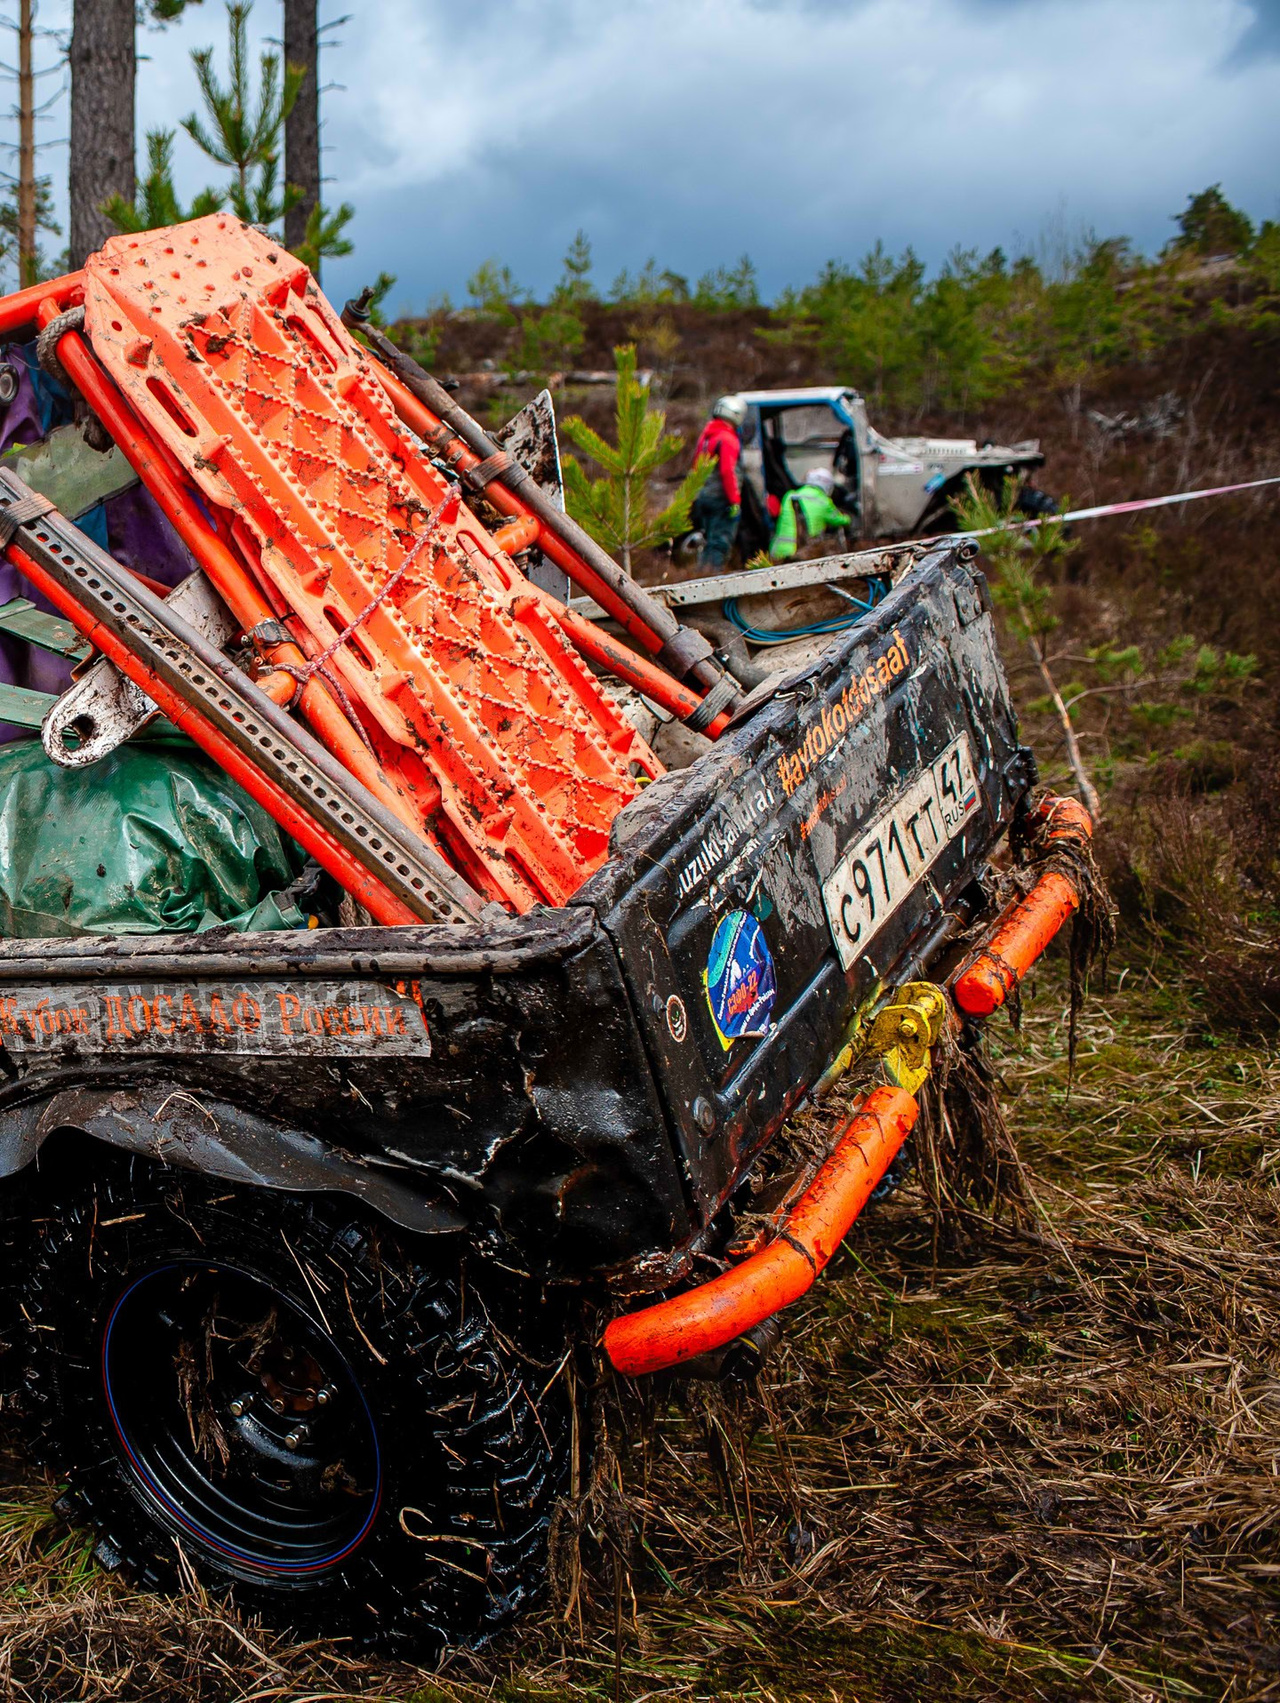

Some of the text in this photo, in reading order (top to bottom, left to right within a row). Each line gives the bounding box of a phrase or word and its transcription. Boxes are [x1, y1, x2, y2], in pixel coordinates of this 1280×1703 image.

[945, 801, 965, 831] RUS
[103, 991, 263, 1044] ДОСААФ
[275, 993, 409, 1036] России
